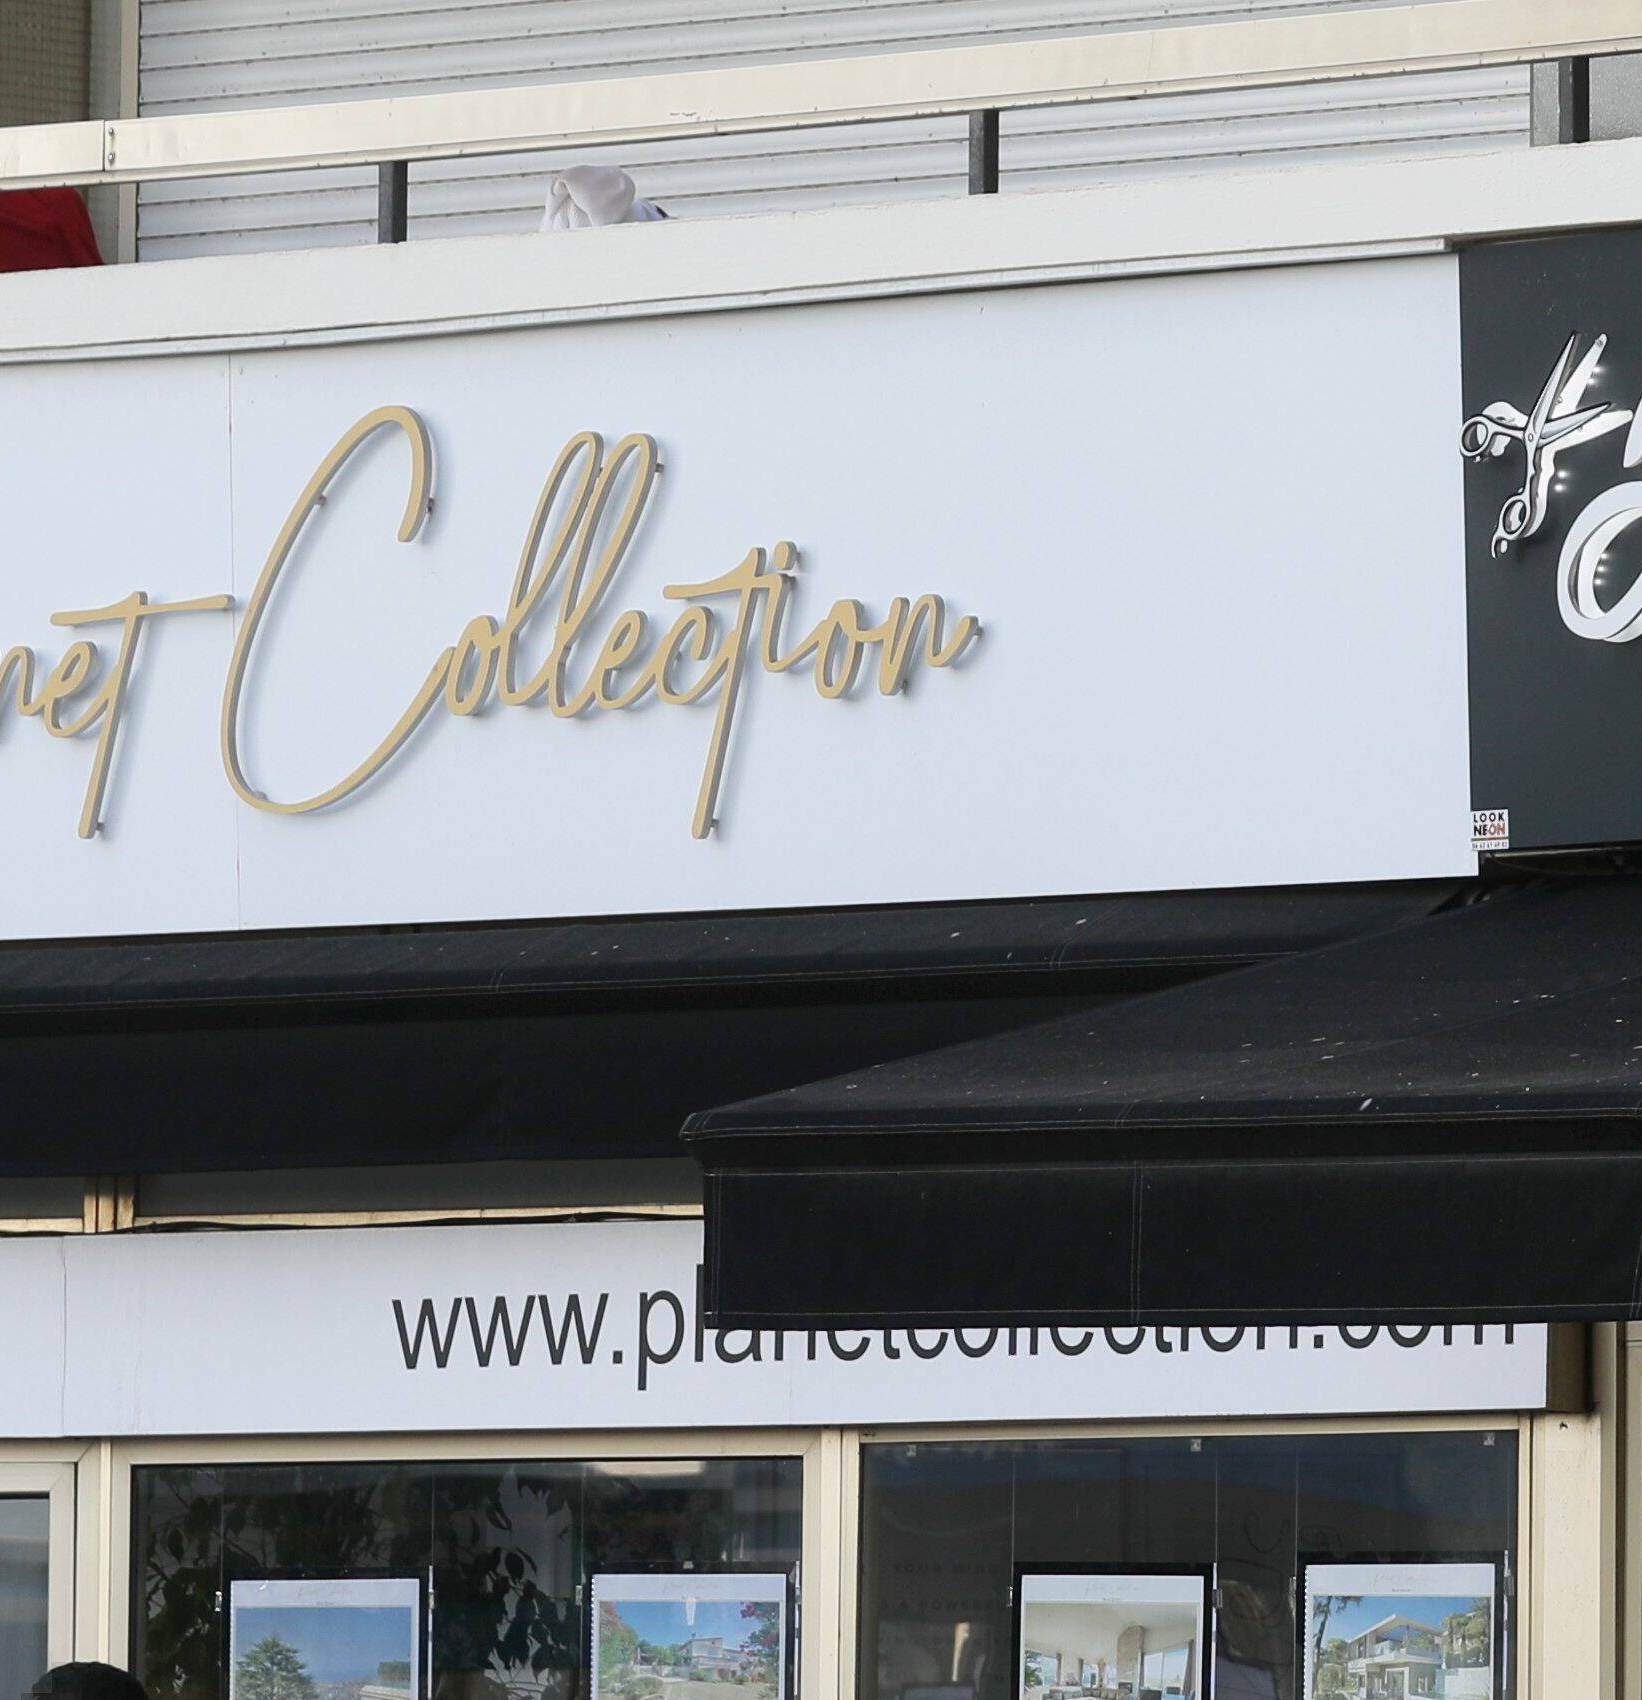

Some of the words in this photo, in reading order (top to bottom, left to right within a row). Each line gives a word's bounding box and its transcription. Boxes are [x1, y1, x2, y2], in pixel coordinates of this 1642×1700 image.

[220, 405, 984, 840] Collection
[1473, 811, 1505, 823] LOOK
[1473, 823, 1506, 837] NEON
